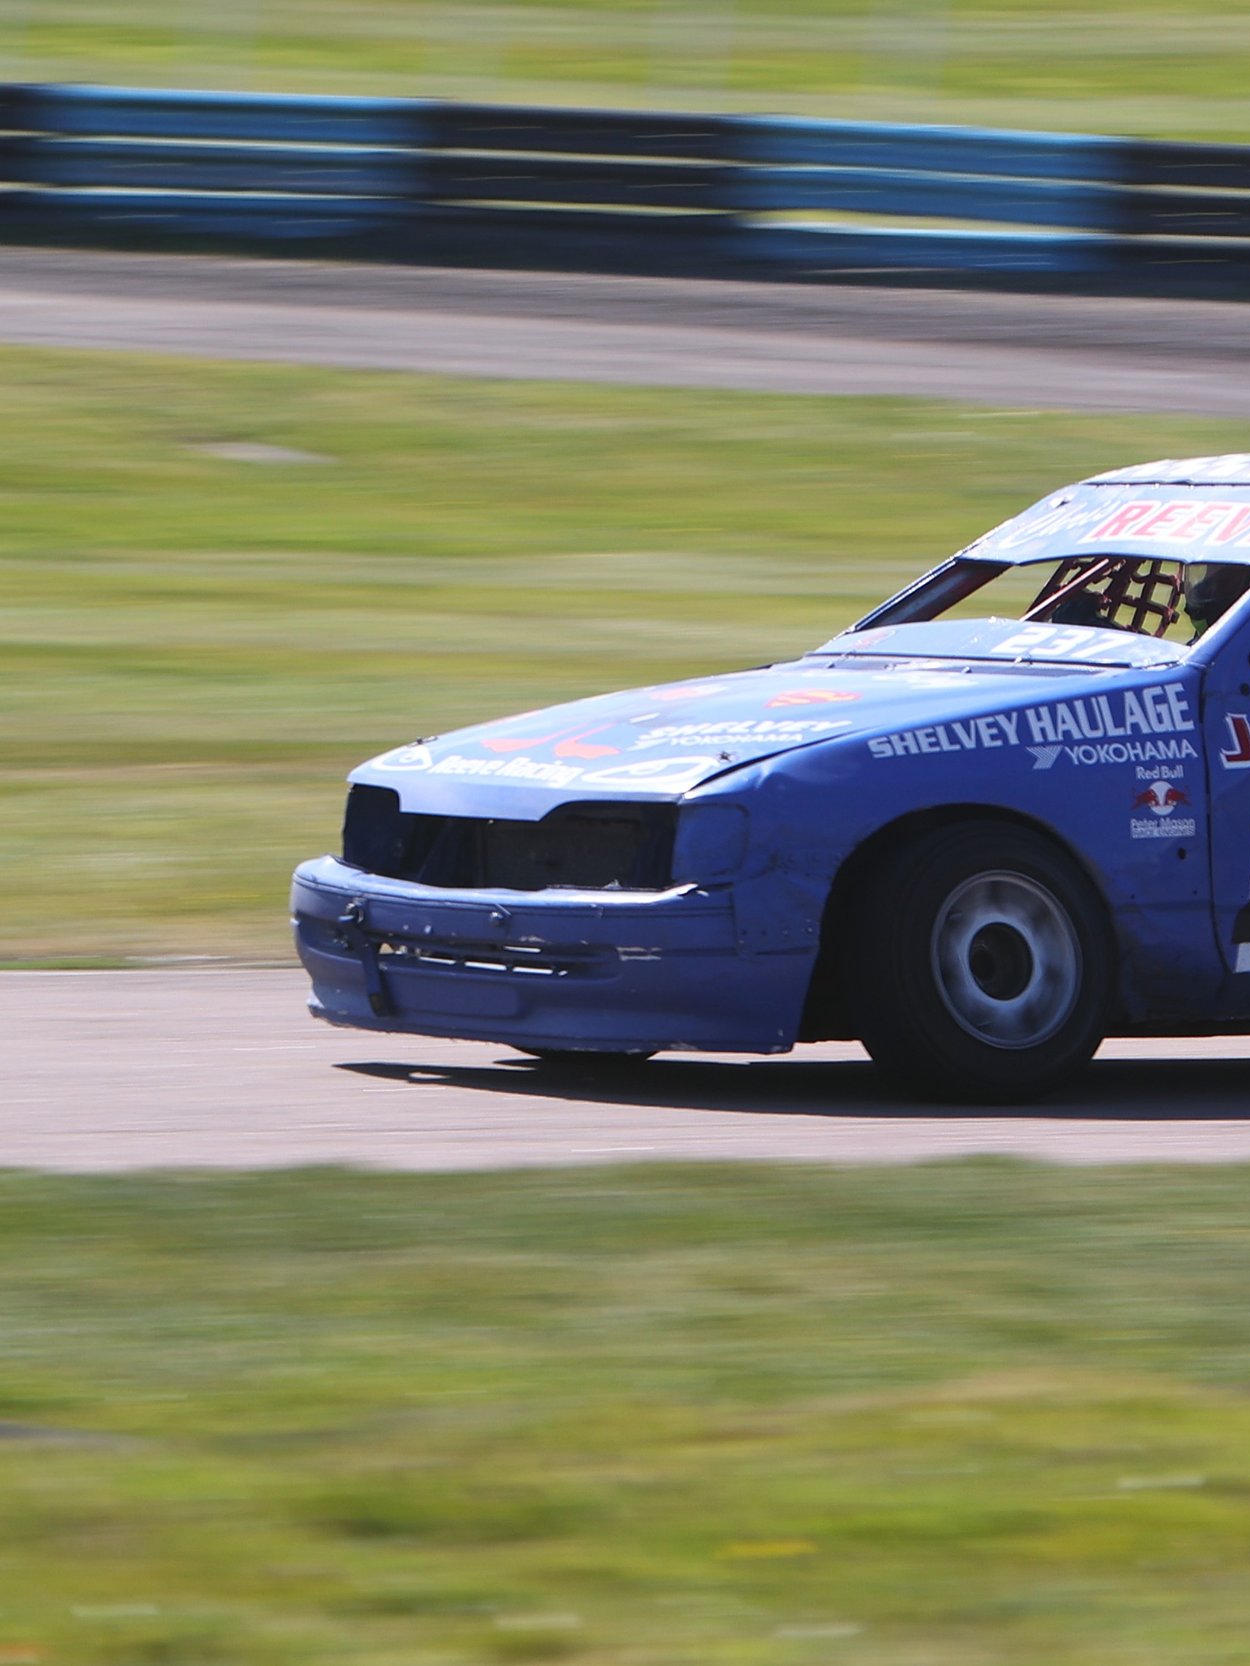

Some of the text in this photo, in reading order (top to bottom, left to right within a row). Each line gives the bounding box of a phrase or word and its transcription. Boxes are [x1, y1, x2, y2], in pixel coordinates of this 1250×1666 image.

[990, 626, 1137, 660] 237
[867, 682, 1195, 758] SHELVEY HAULAGE
[1064, 738, 1198, 766] YOKOHAMA
[1136, 765, 1184, 780] Red Bull
